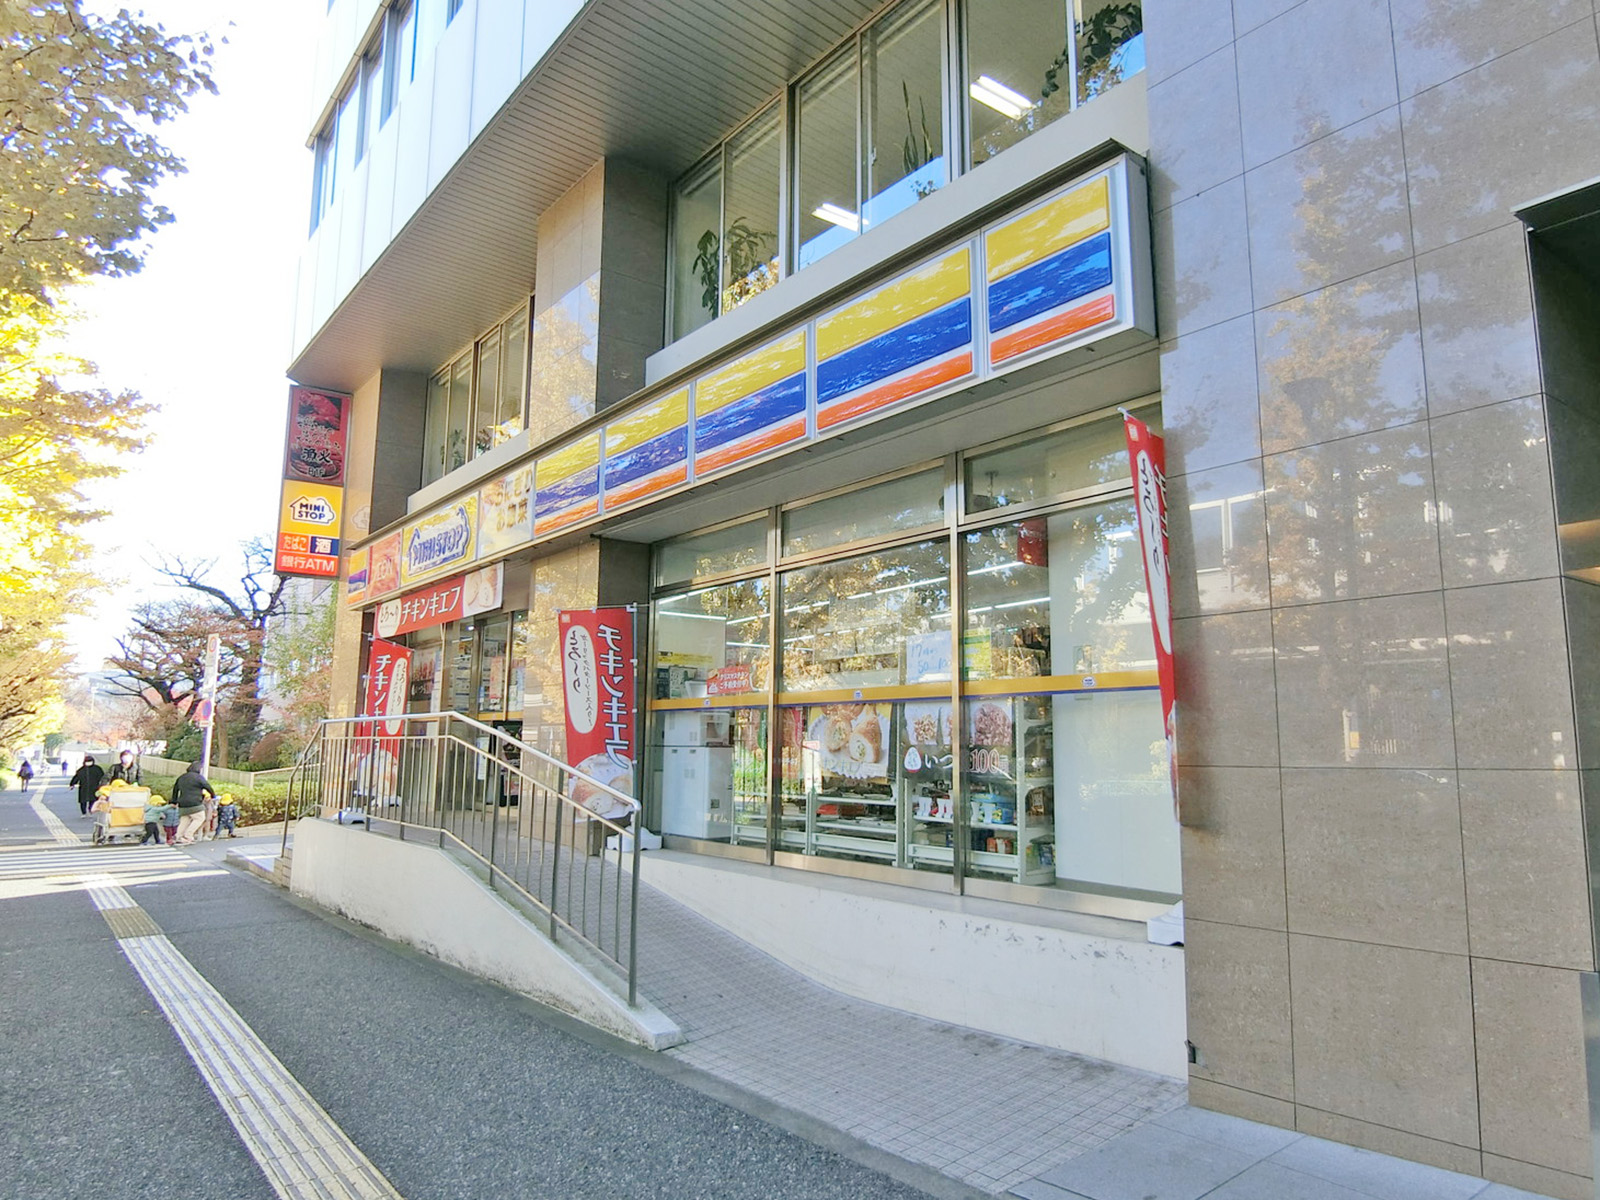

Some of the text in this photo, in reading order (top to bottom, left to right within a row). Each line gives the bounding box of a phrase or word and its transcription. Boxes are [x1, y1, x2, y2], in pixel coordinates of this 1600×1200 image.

[299, 502, 325, 512] MINI
[297, 511, 326, 520] STOP
[283, 536, 307, 551] たばこ
[315, 538, 332, 554] 酒
[280, 556, 335, 573] 銀行ATM
[401, 586, 461, 625] チキンキエフ
